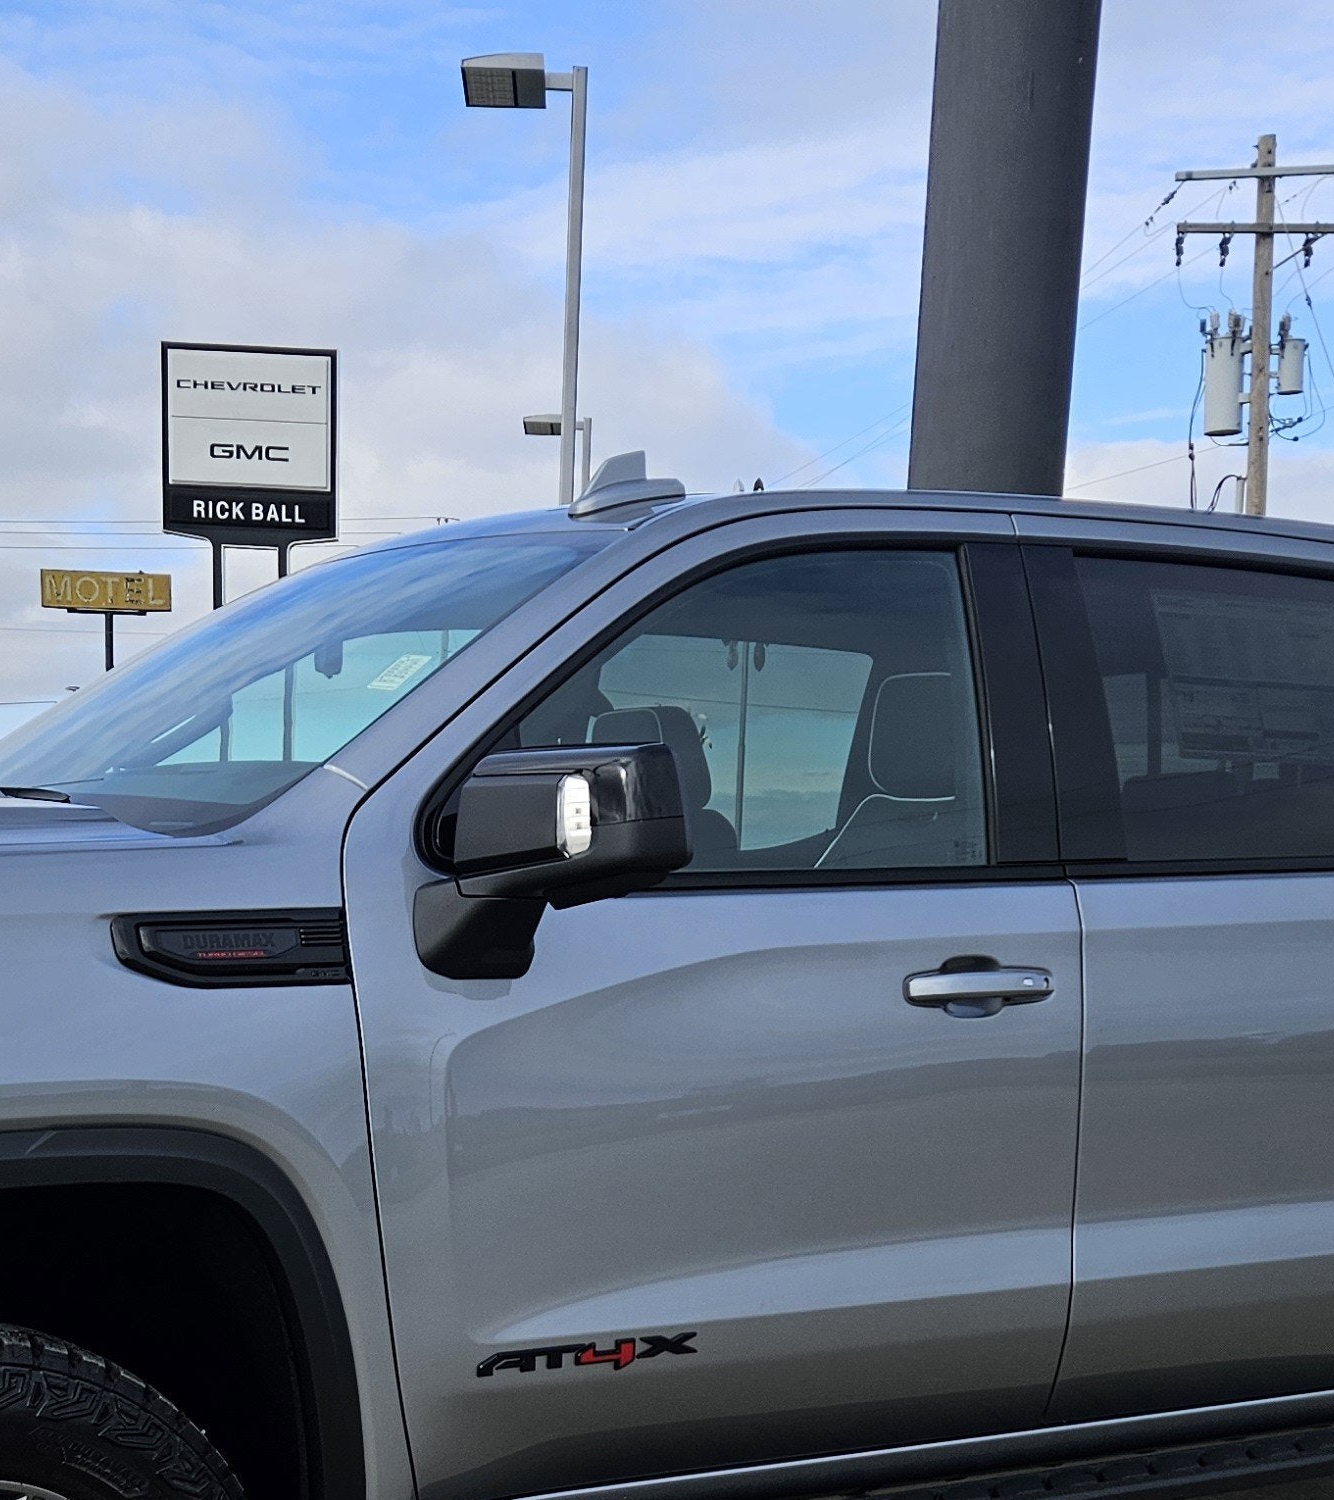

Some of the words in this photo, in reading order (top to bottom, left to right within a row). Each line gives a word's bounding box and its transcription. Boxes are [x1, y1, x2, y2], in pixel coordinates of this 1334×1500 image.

[175, 379, 322, 395] CHEVROLET
[209, 443, 290, 462] GMC
[192, 500, 245, 520] RICK
[251, 503, 306, 523] BALL
[45, 573, 167, 606] MOTEL
[476, 1331, 698, 1378] AT4X
